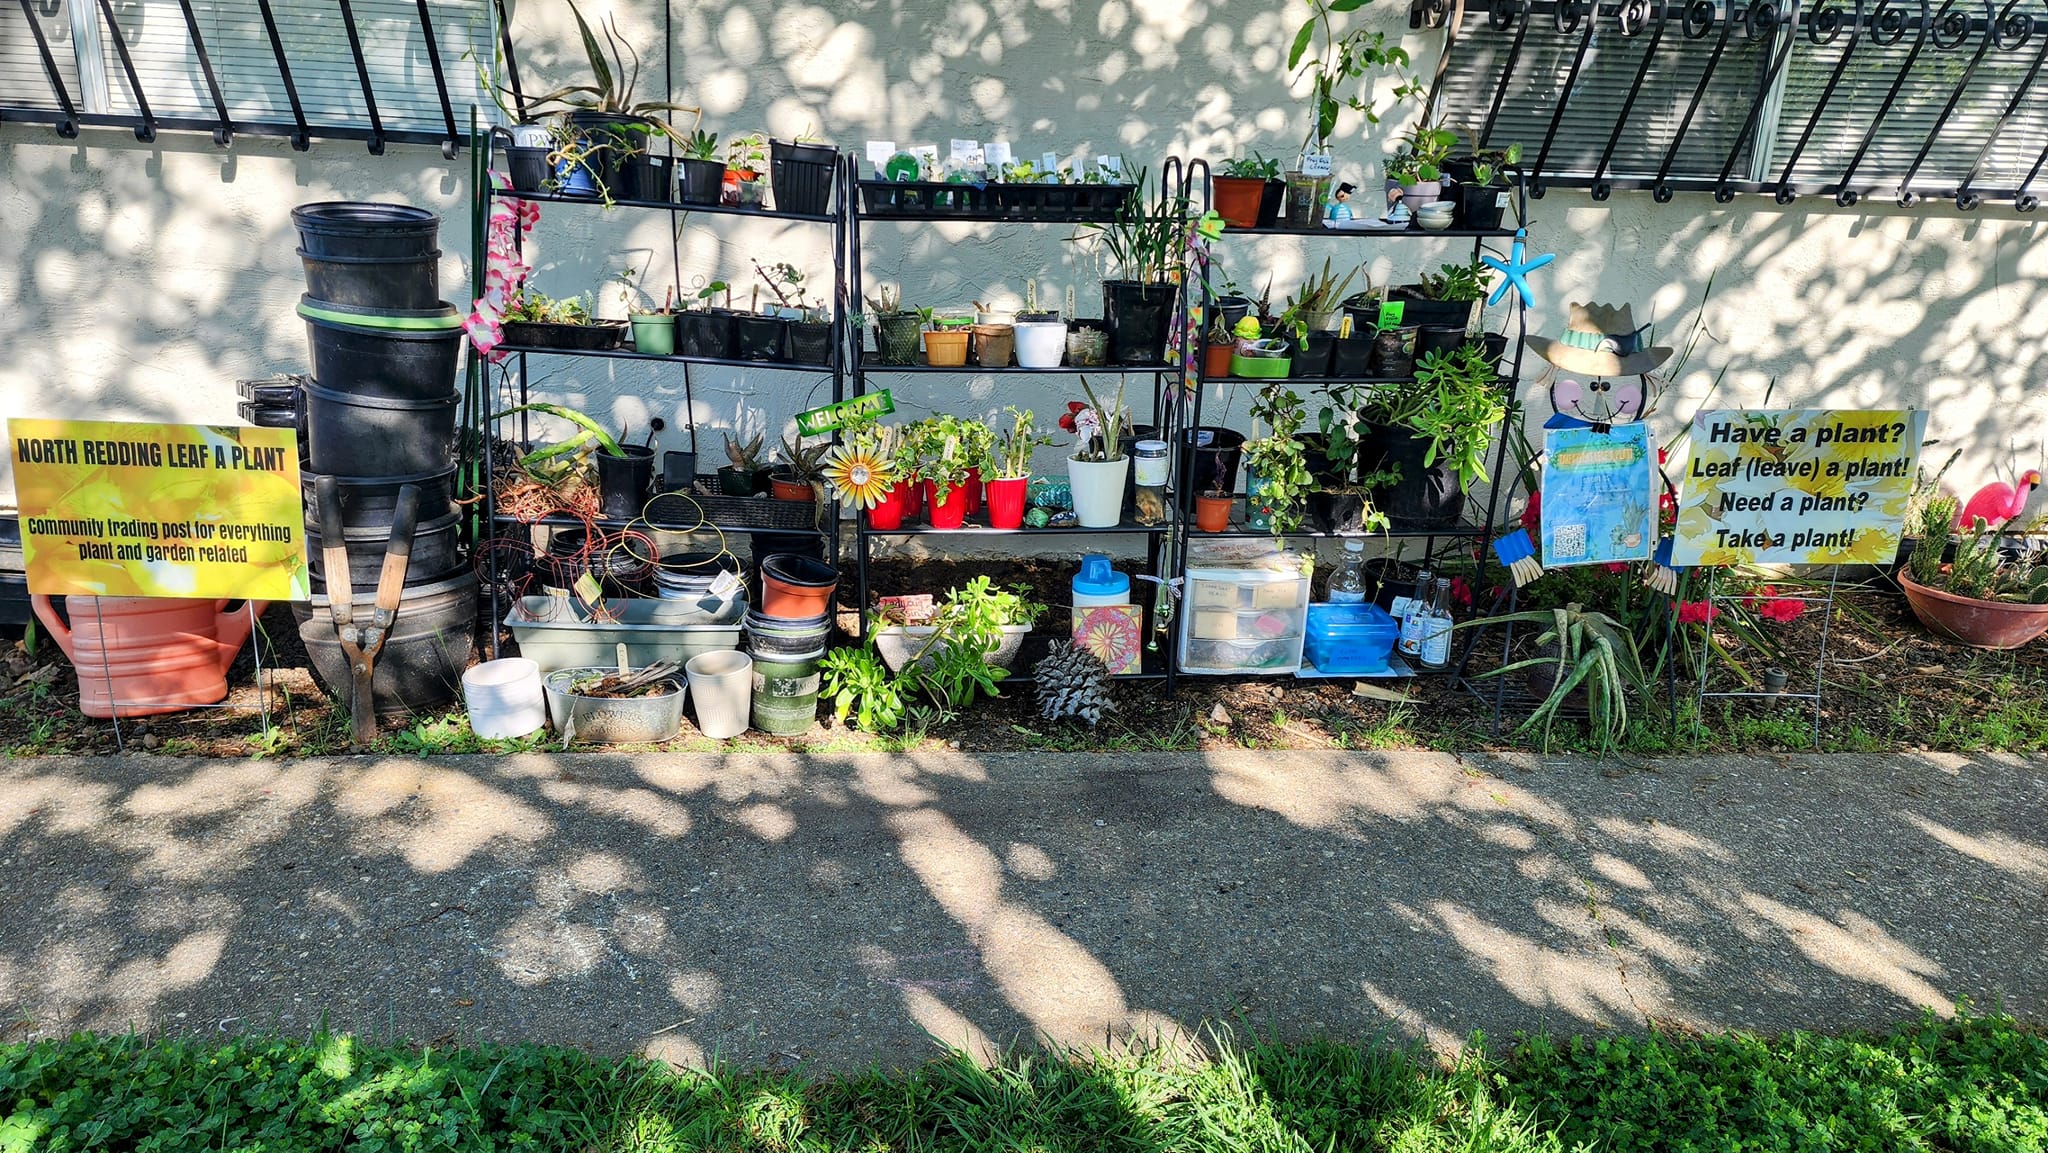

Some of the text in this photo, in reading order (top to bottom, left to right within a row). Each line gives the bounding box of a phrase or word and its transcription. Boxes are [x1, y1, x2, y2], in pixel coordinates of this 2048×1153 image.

[799, 394, 890, 432] WELCOME
[1710, 422, 1906, 447] Have a plant?
[17, 438, 285, 471] NORTH REDDING LEAF A PLANT
[1692, 457, 1910, 482] Leaf (leave) a plant!
[1719, 491, 1870, 516] Need a plant?
[28, 517, 291, 544] Community trading post for everything
[1716, 528, 1856, 552] Take a plant!
[79, 541, 248, 564] plant and garden related
[582, 709, 646, 724] FLOWERS
[590, 725, 636, 735] GARDEN
